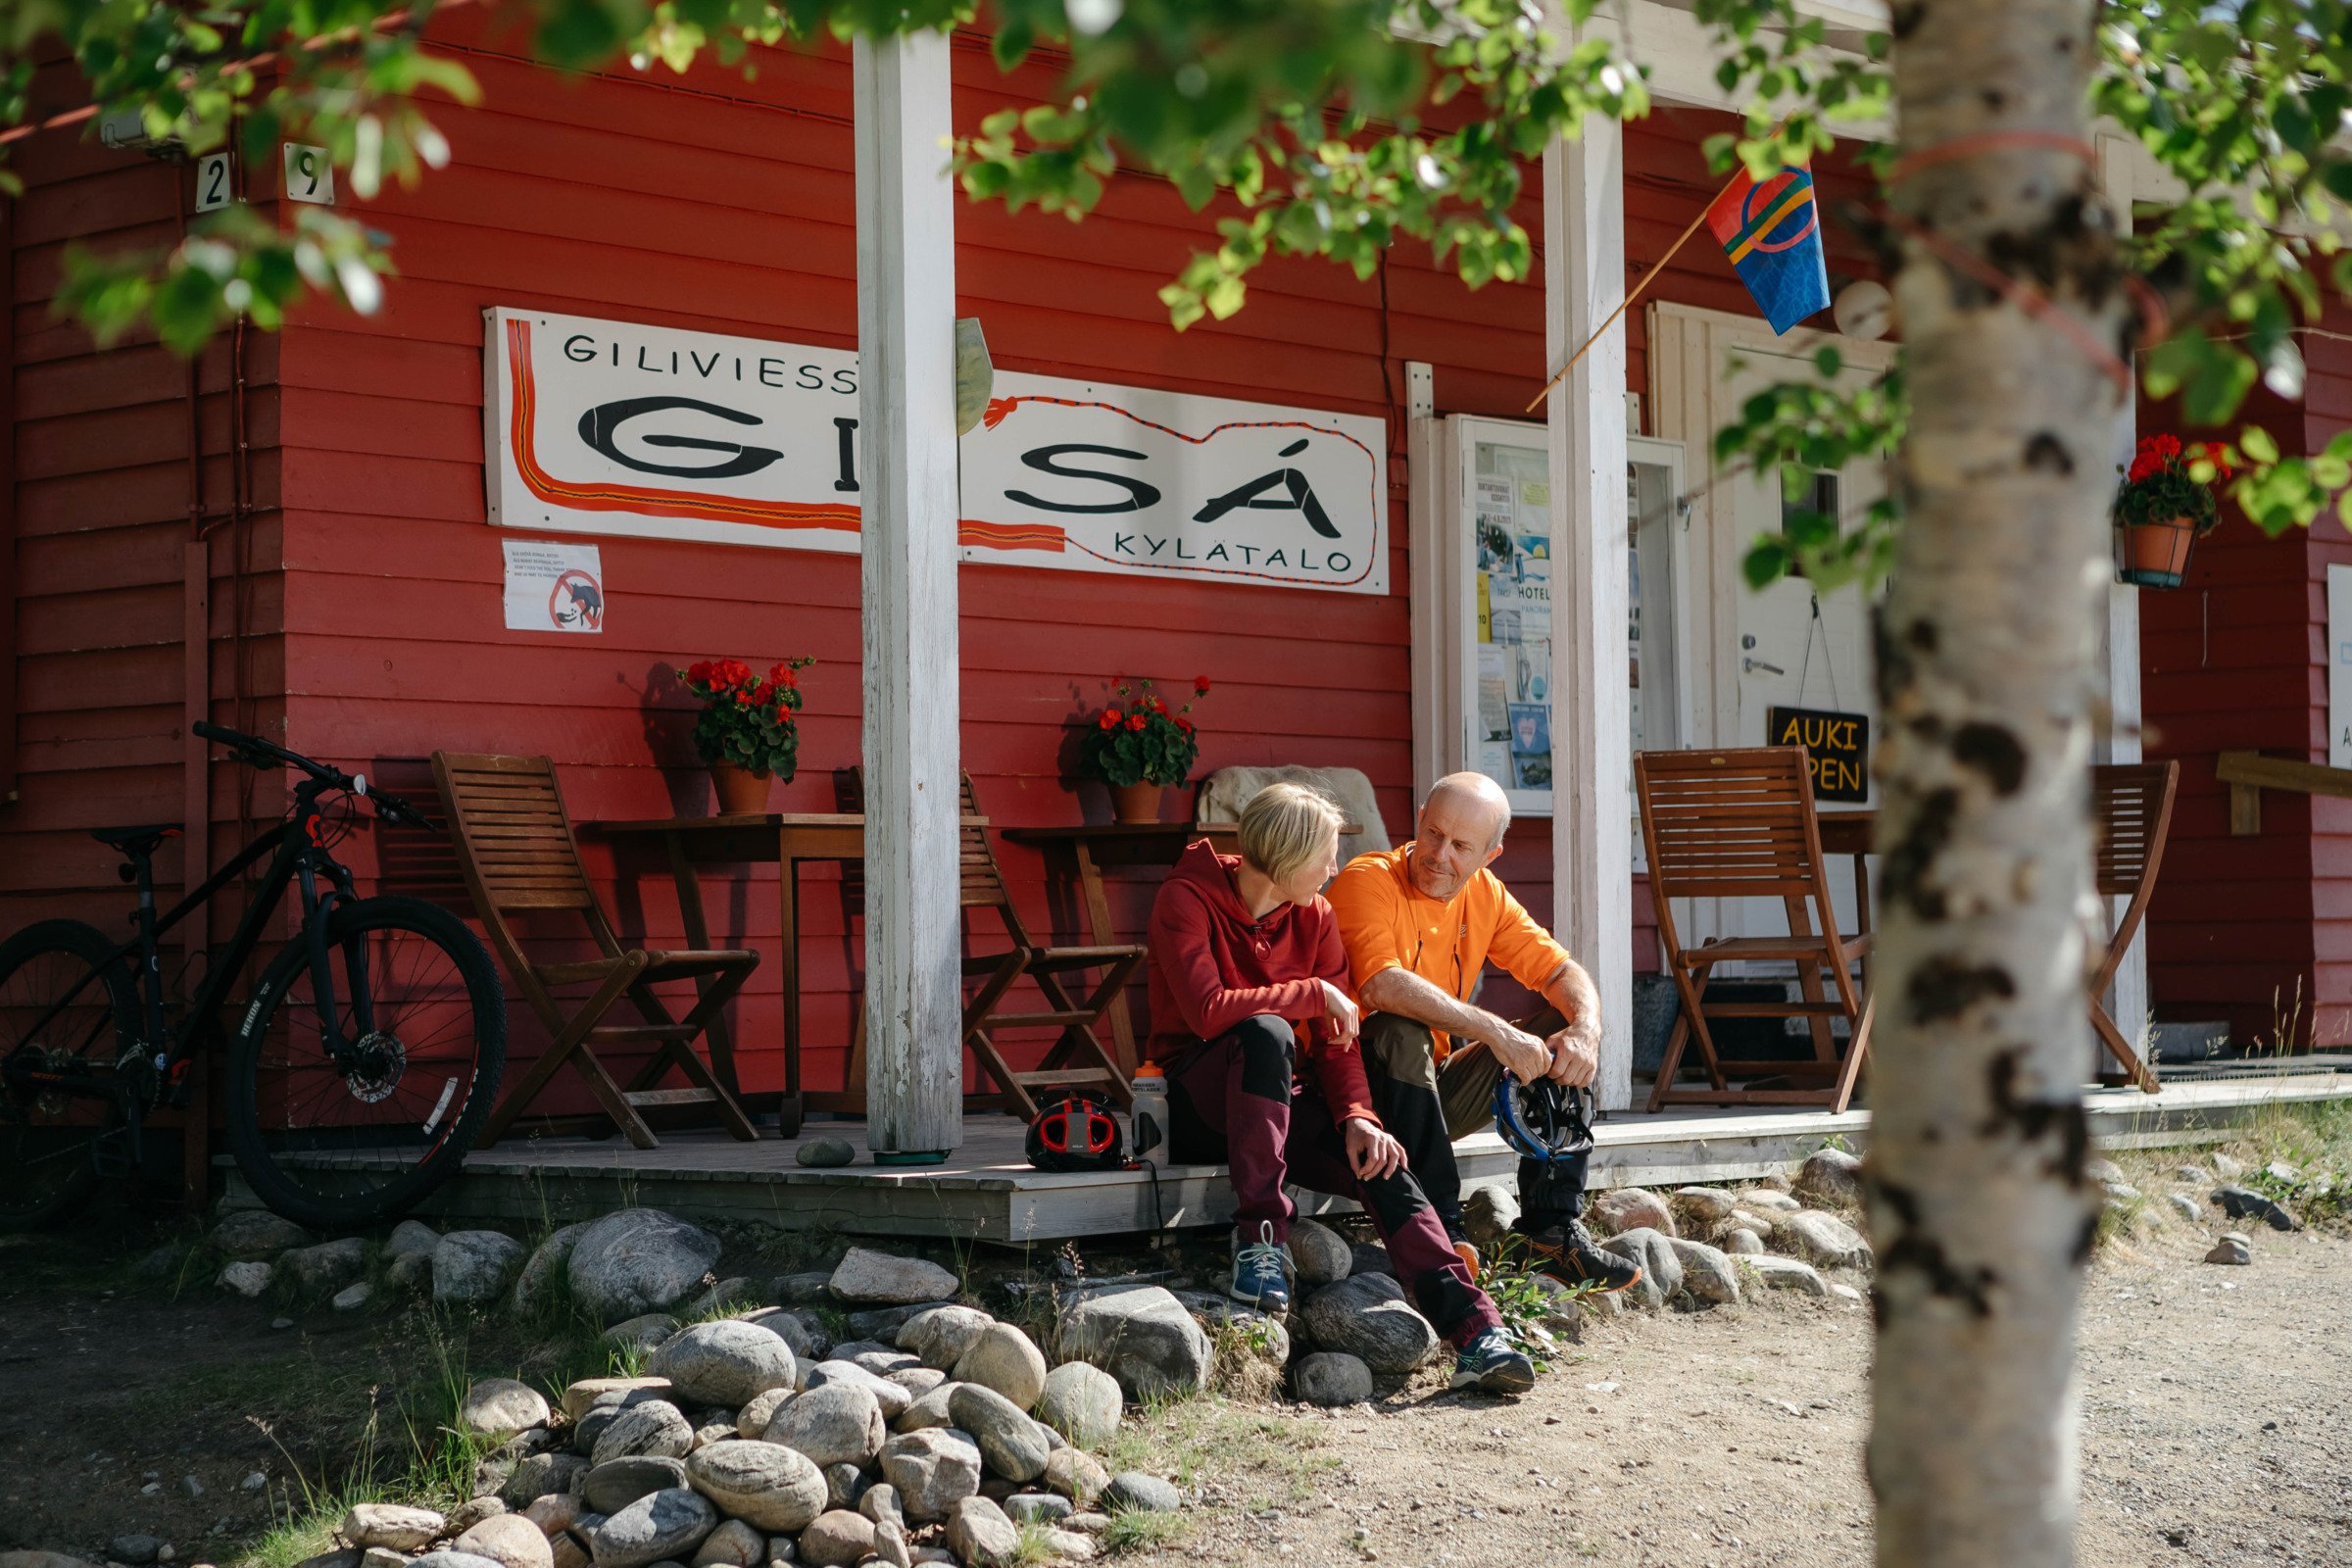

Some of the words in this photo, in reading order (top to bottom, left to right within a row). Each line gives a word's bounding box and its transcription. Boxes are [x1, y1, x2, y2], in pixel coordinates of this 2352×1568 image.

[206, 160, 224, 204] 2
[299, 152, 319, 195] 9
[564, 335, 858, 394] GILIVIESS
[1114, 532, 1351, 572] KYLÄTALO
[1518, 586, 1550, 600] HOTEL
[1783, 716, 1858, 750] AUKI
[1808, 757, 1859, 791] PEN
